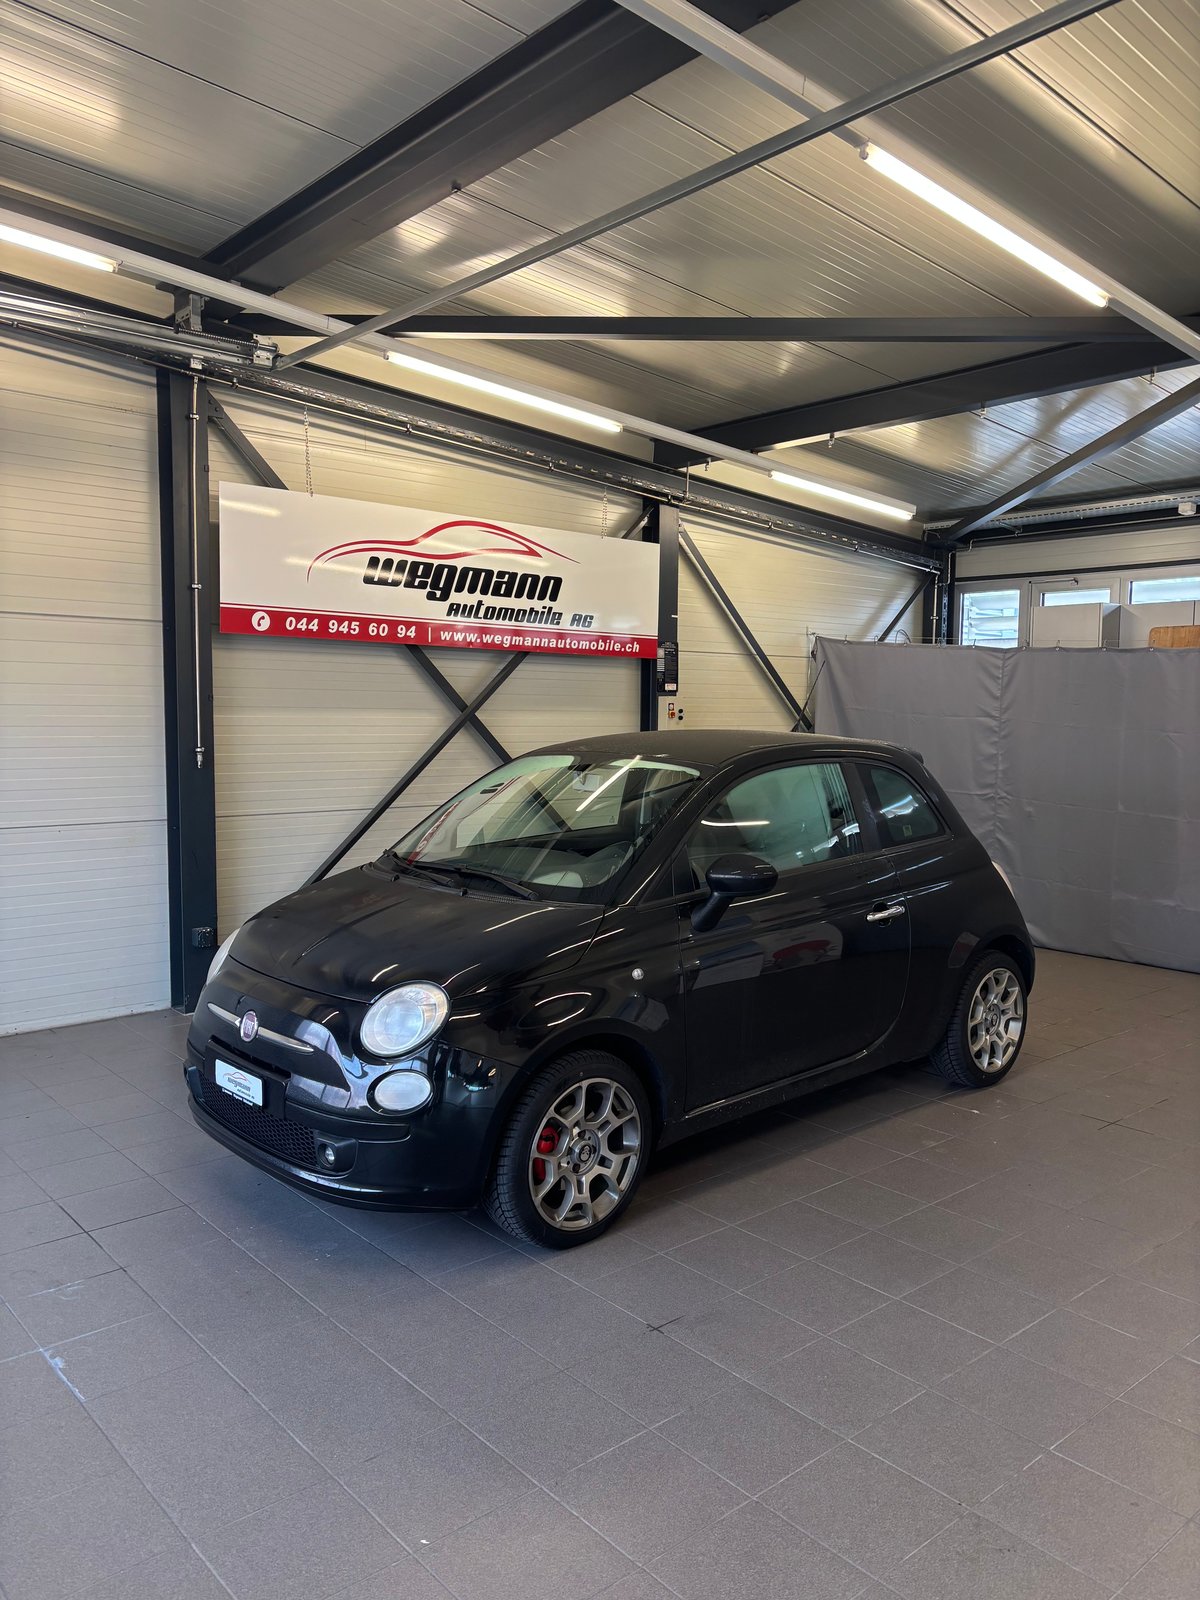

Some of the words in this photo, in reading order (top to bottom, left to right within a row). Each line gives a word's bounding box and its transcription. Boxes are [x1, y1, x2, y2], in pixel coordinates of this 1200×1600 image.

[285, 616, 319, 632] 044
[328, 619, 360, 635] 945
[368, 622, 389, 637] 60
[396, 625, 417, 639] 94
[569, 613, 595, 629] AG
[440, 630, 640, 653] www.wegmannautomobile.ch
